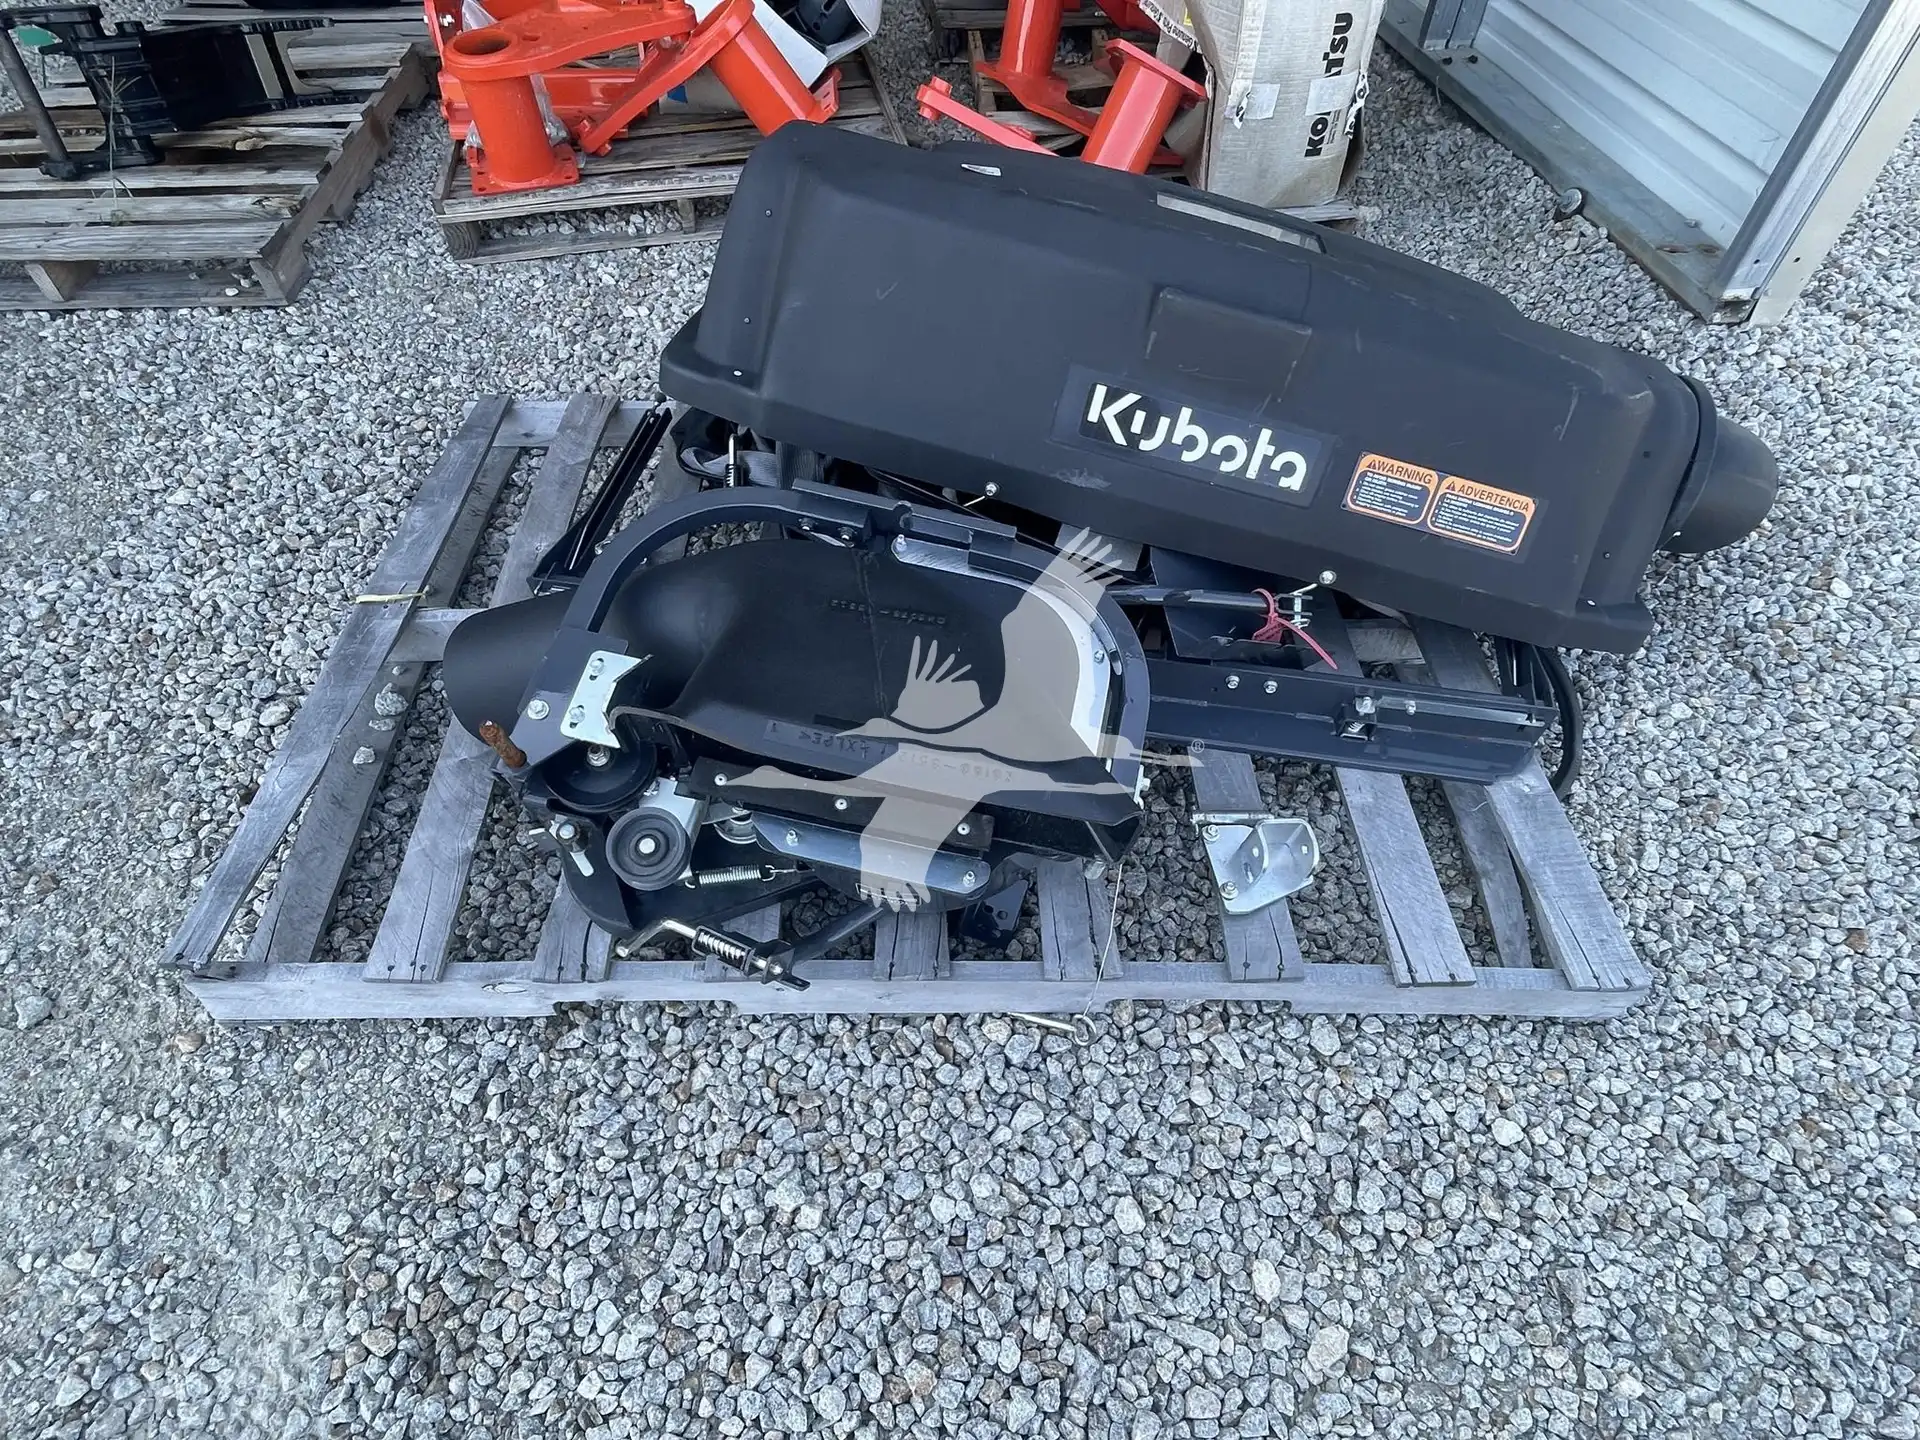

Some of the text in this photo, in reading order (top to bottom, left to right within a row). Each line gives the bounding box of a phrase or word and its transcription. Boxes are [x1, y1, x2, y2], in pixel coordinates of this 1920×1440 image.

[1304, 12, 1354, 158] KOTSU
[1087, 384, 1307, 491] Kubota
[1377, 460, 1433, 485] WARNING
[1458, 484, 1530, 512] ADVERTENCIA
